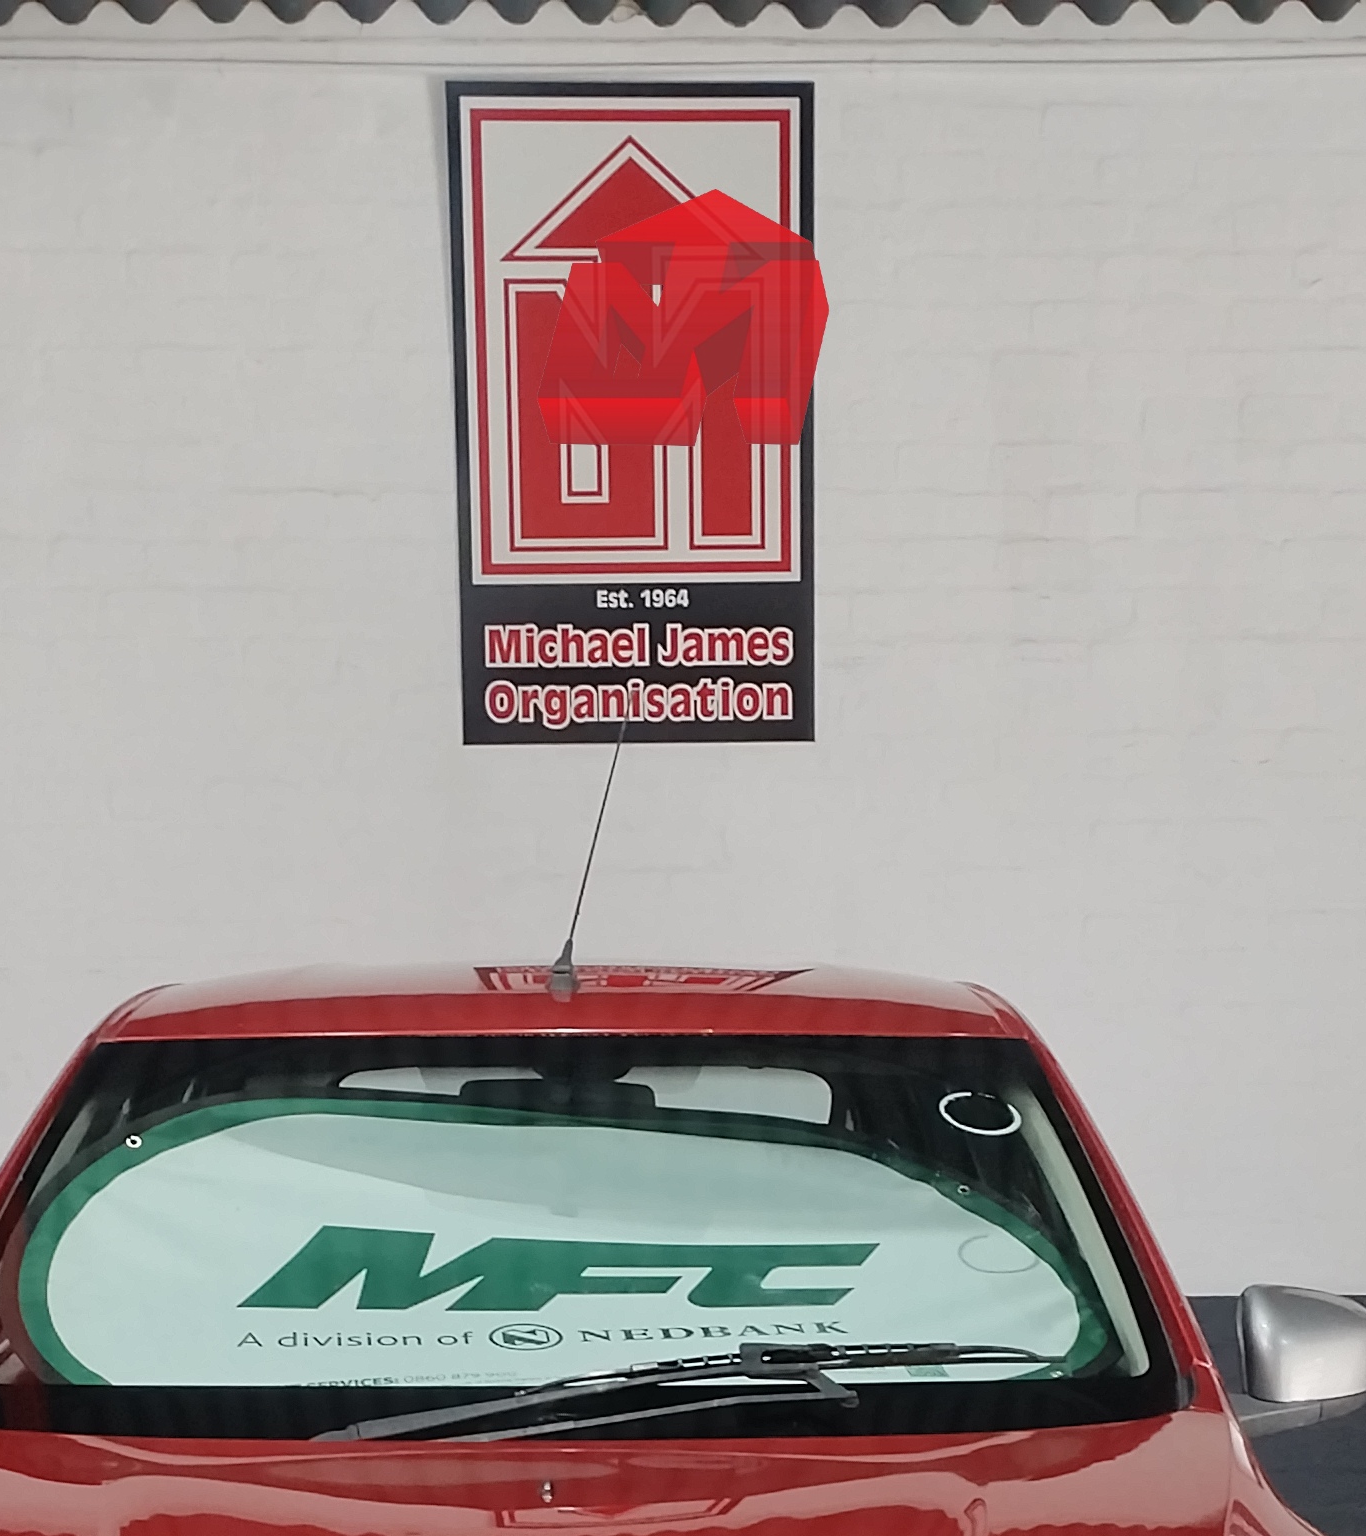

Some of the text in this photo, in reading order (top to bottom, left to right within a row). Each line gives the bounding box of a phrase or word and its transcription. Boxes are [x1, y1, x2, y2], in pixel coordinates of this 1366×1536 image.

[596, 588, 689, 609] Est. 1964
[484, 623, 793, 668] Michael James
[484, 677, 793, 729] Organisation
[237, 1225, 880, 1313] MFC
[237, 1332, 263, 1348] A
[277, 1331, 422, 1348] division
[436, 1331, 473, 1346] of
[577, 1321, 849, 1343] NEDBANK
